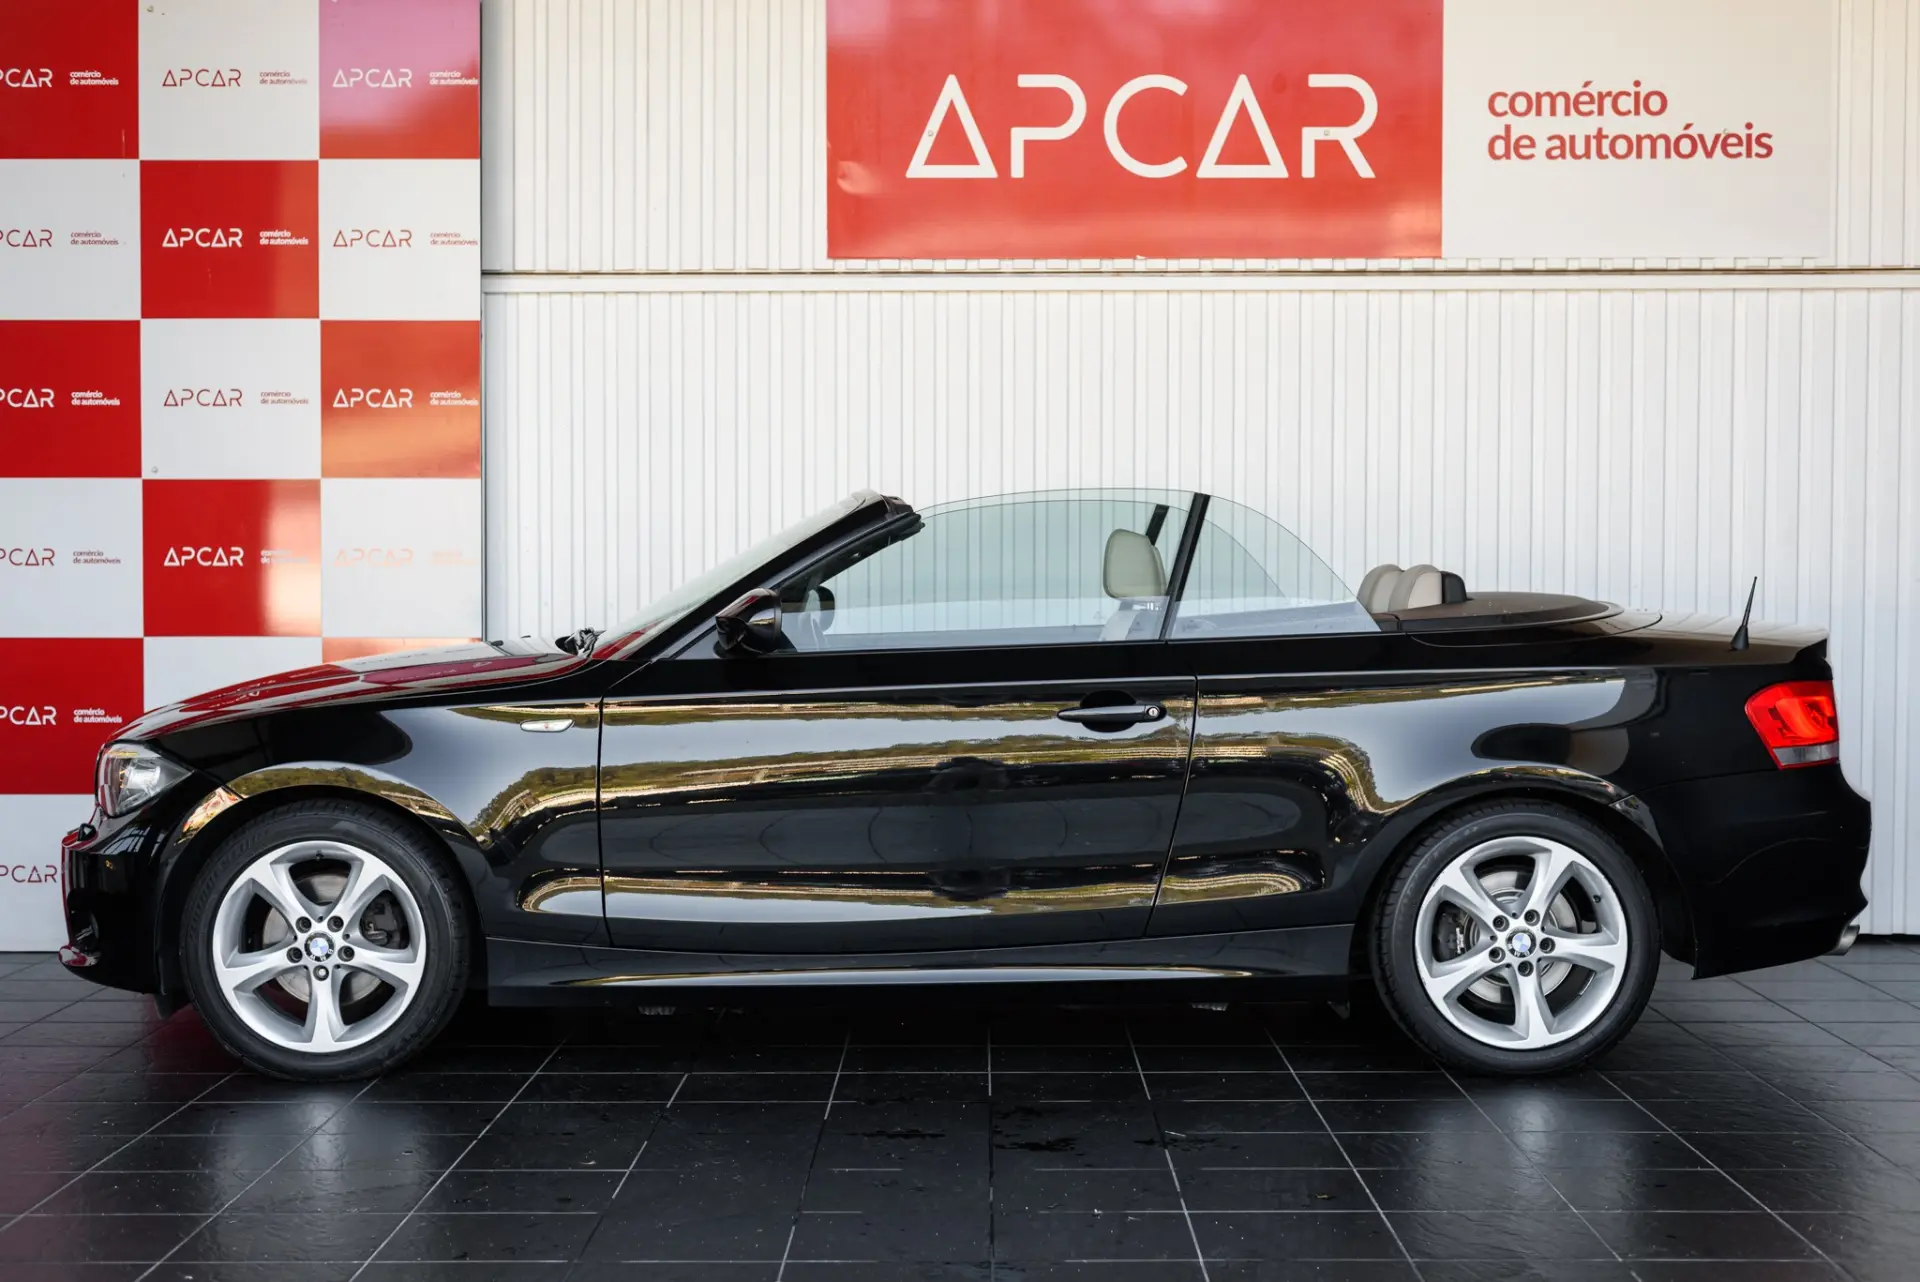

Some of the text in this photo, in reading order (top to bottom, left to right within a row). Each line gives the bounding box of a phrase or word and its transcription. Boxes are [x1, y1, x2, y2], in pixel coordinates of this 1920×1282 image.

[0, 68, 54, 88] CAR
[69, 70, 102, 78] comércio
[69, 78, 78, 86] de
[161, 68, 242, 88] APCAR
[332, 68, 413, 88] APCAR
[429, 78, 438, 86] de
[1488, 79, 1669, 118] comércio
[905, 74, 1379, 179] APCAR
[1488, 121, 1774, 161] de automóveis
[0, 229, 53, 248] CAR
[70, 230, 102, 238] comércio
[70, 238, 79, 246] de
[161, 227, 243, 248] APCAR
[259, 230, 292, 238] comércio
[259, 238, 268, 246] de
[332, 228, 413, 248] APCAR
[429, 238, 438, 246] de
[0, 388, 55, 408] CAR
[71, 398, 80, 406] de
[163, 388, 243, 407] APCAR
[332, 387, 414, 408] APCAR
[72, 549, 104, 557] comércio
[72, 557, 81, 565] de
[163, 546, 245, 567] APCAR
[0, 705, 57, 726] PCAR
[73, 715, 82, 723] de
[0, 864, 58, 884] PCAR
